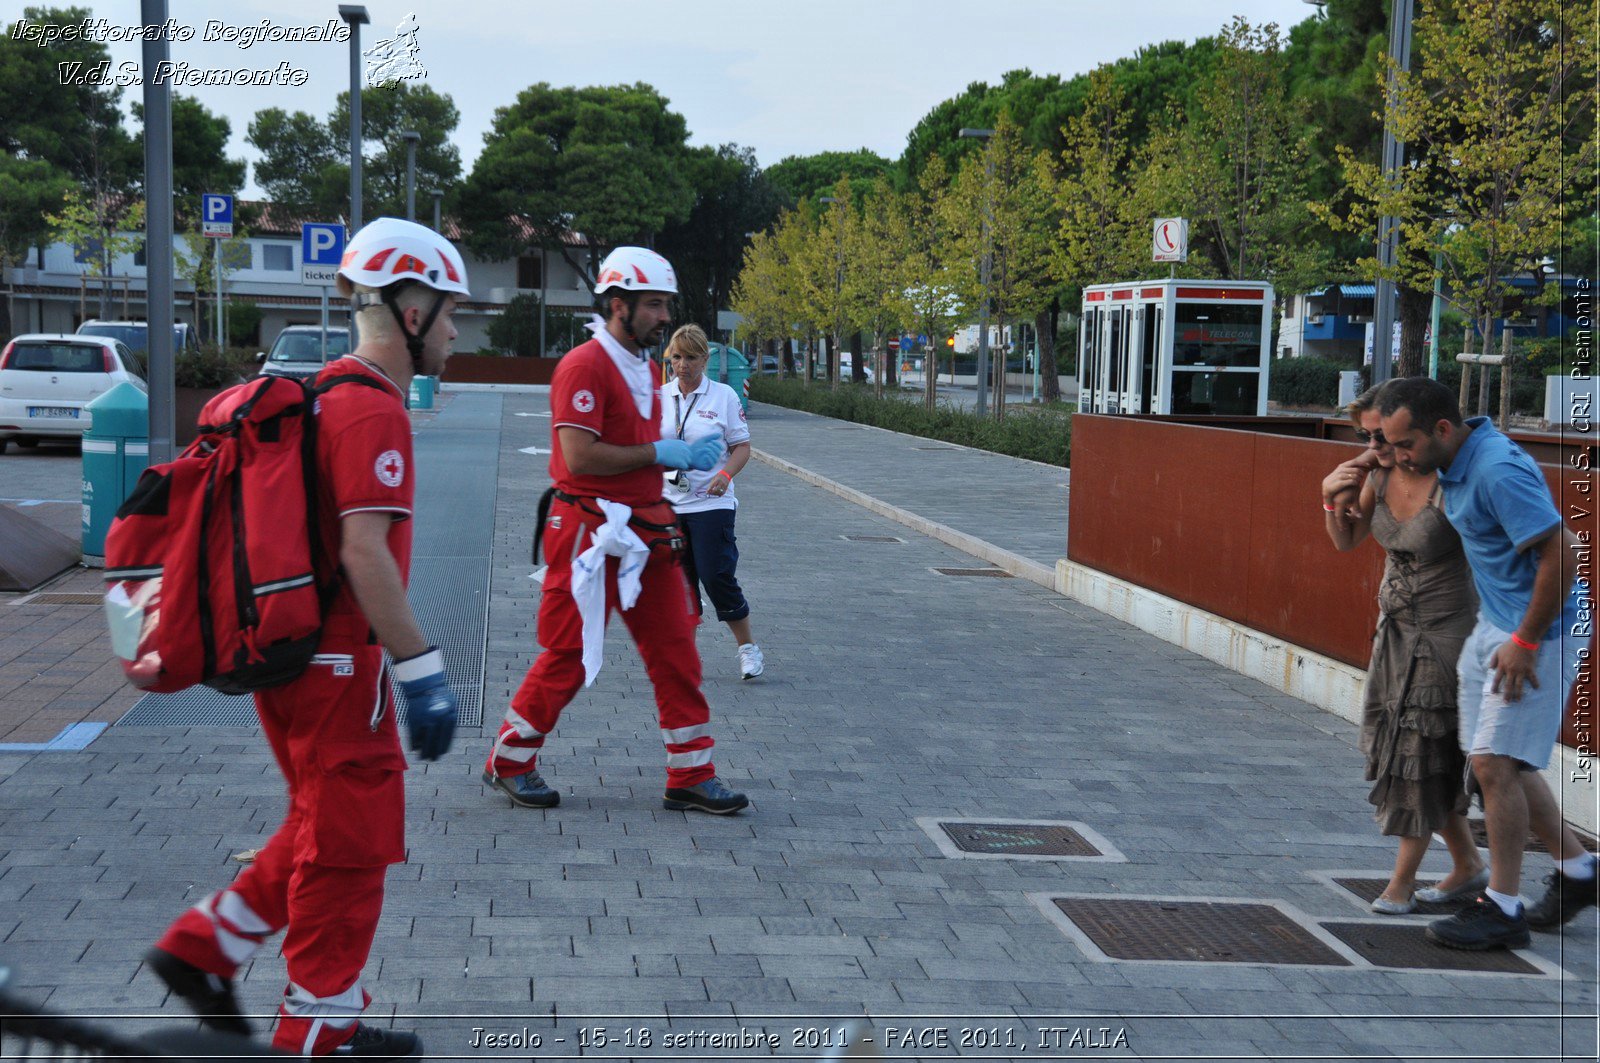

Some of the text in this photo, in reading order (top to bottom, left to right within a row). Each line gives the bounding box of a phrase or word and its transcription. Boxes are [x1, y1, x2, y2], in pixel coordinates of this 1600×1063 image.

[208, 196, 227, 221] P
[310, 227, 336, 261] P
[305, 271, 336, 281] ticket
[1209, 330, 1254, 339] TELECOM
